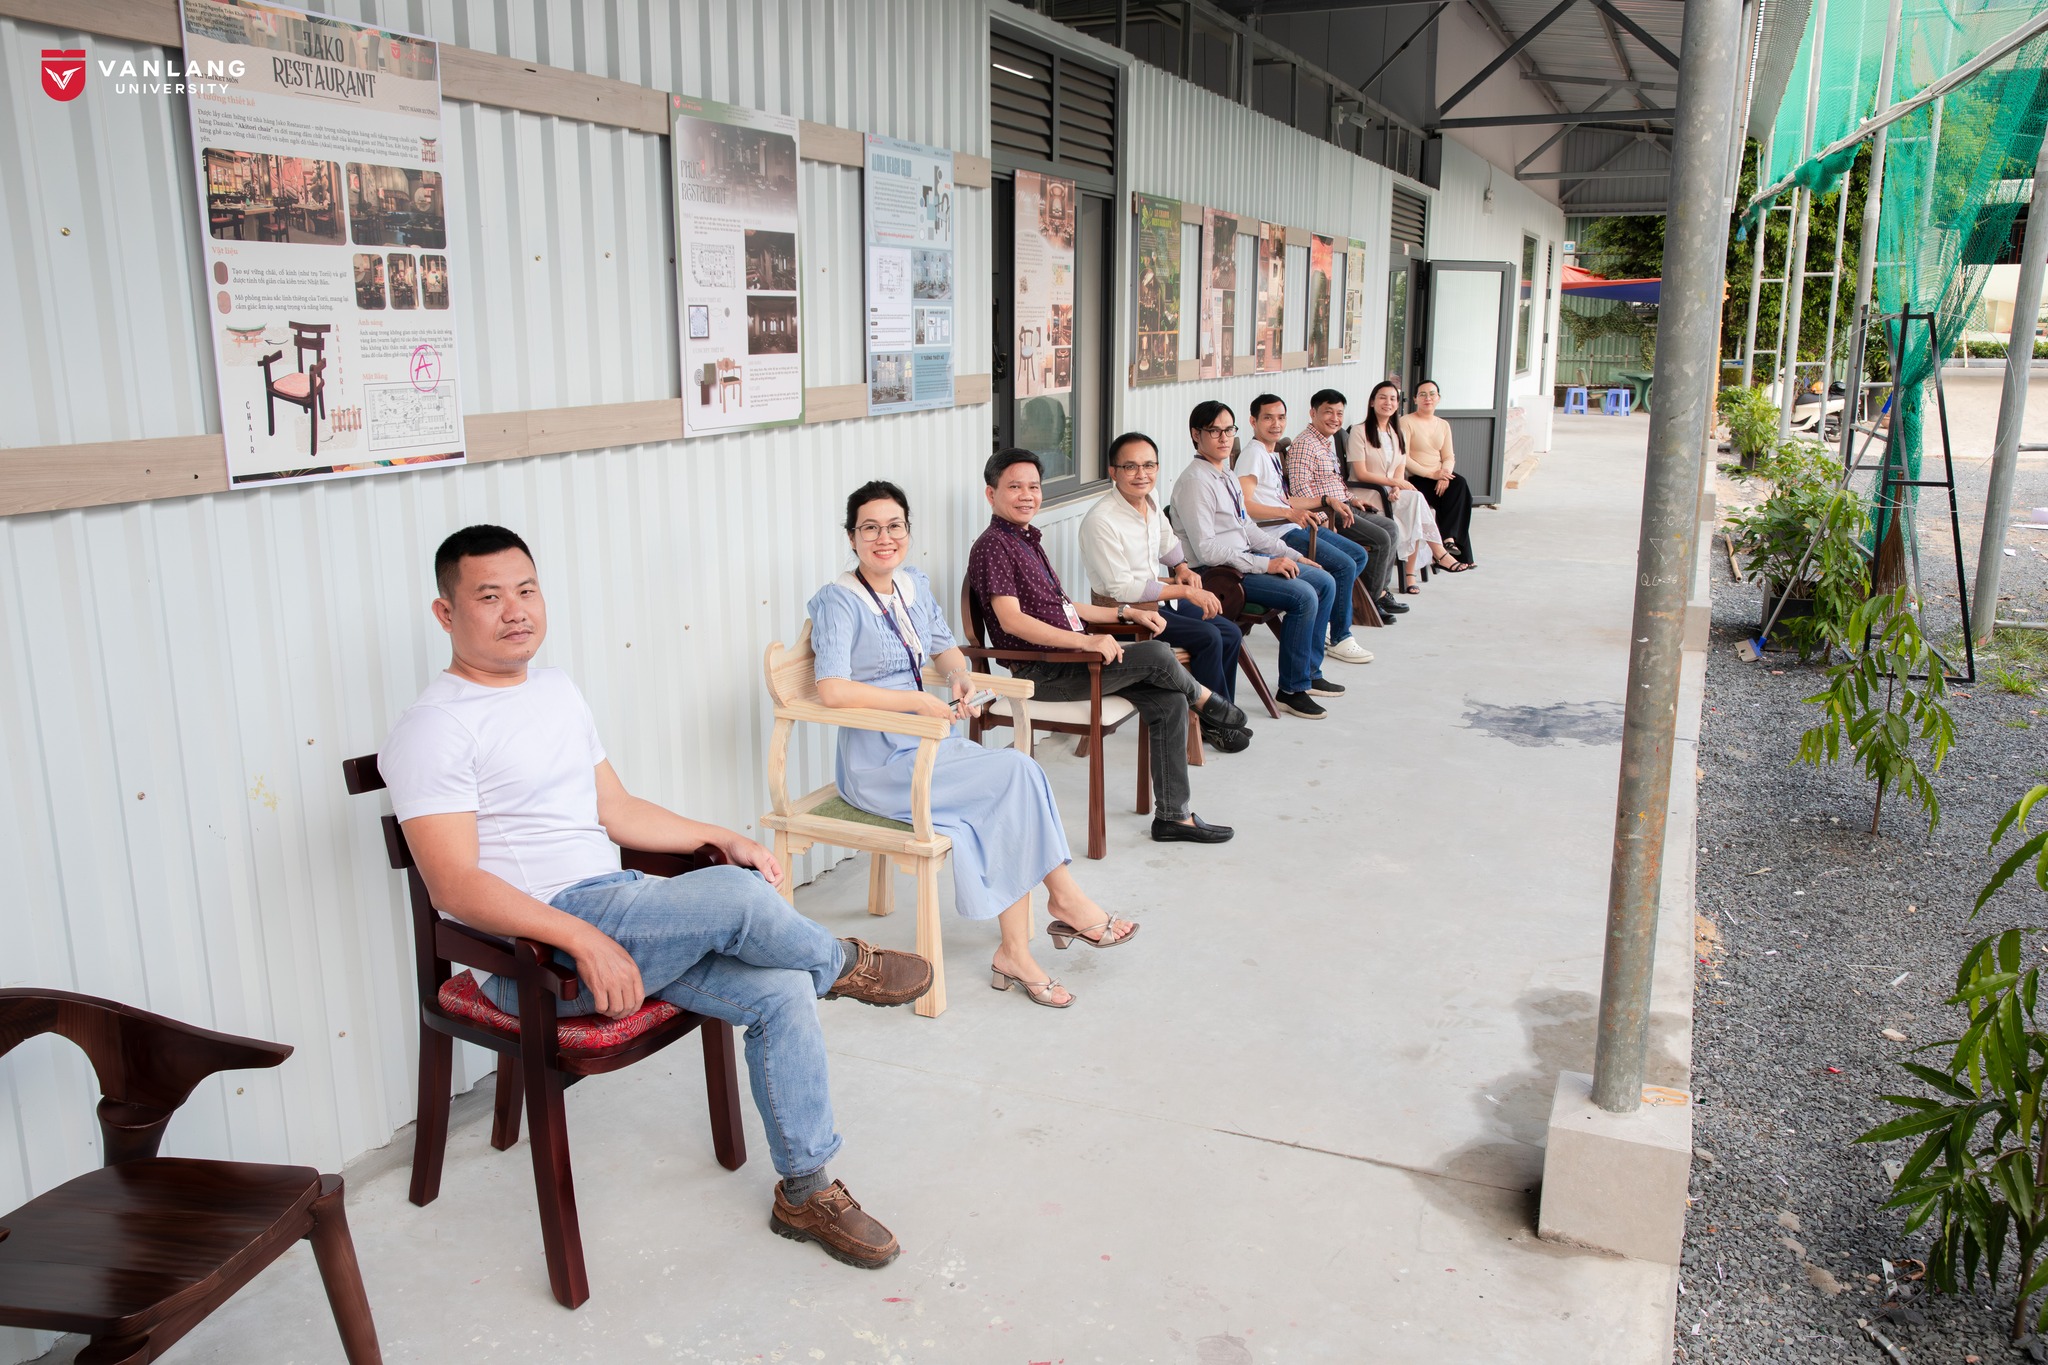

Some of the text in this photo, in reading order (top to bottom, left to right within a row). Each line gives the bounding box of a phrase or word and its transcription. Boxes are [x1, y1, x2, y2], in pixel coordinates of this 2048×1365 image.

[303, 31, 345, 63] JAKO
[272, 56, 376, 98] RESTAURANT
[414, 354, 433, 380] A
